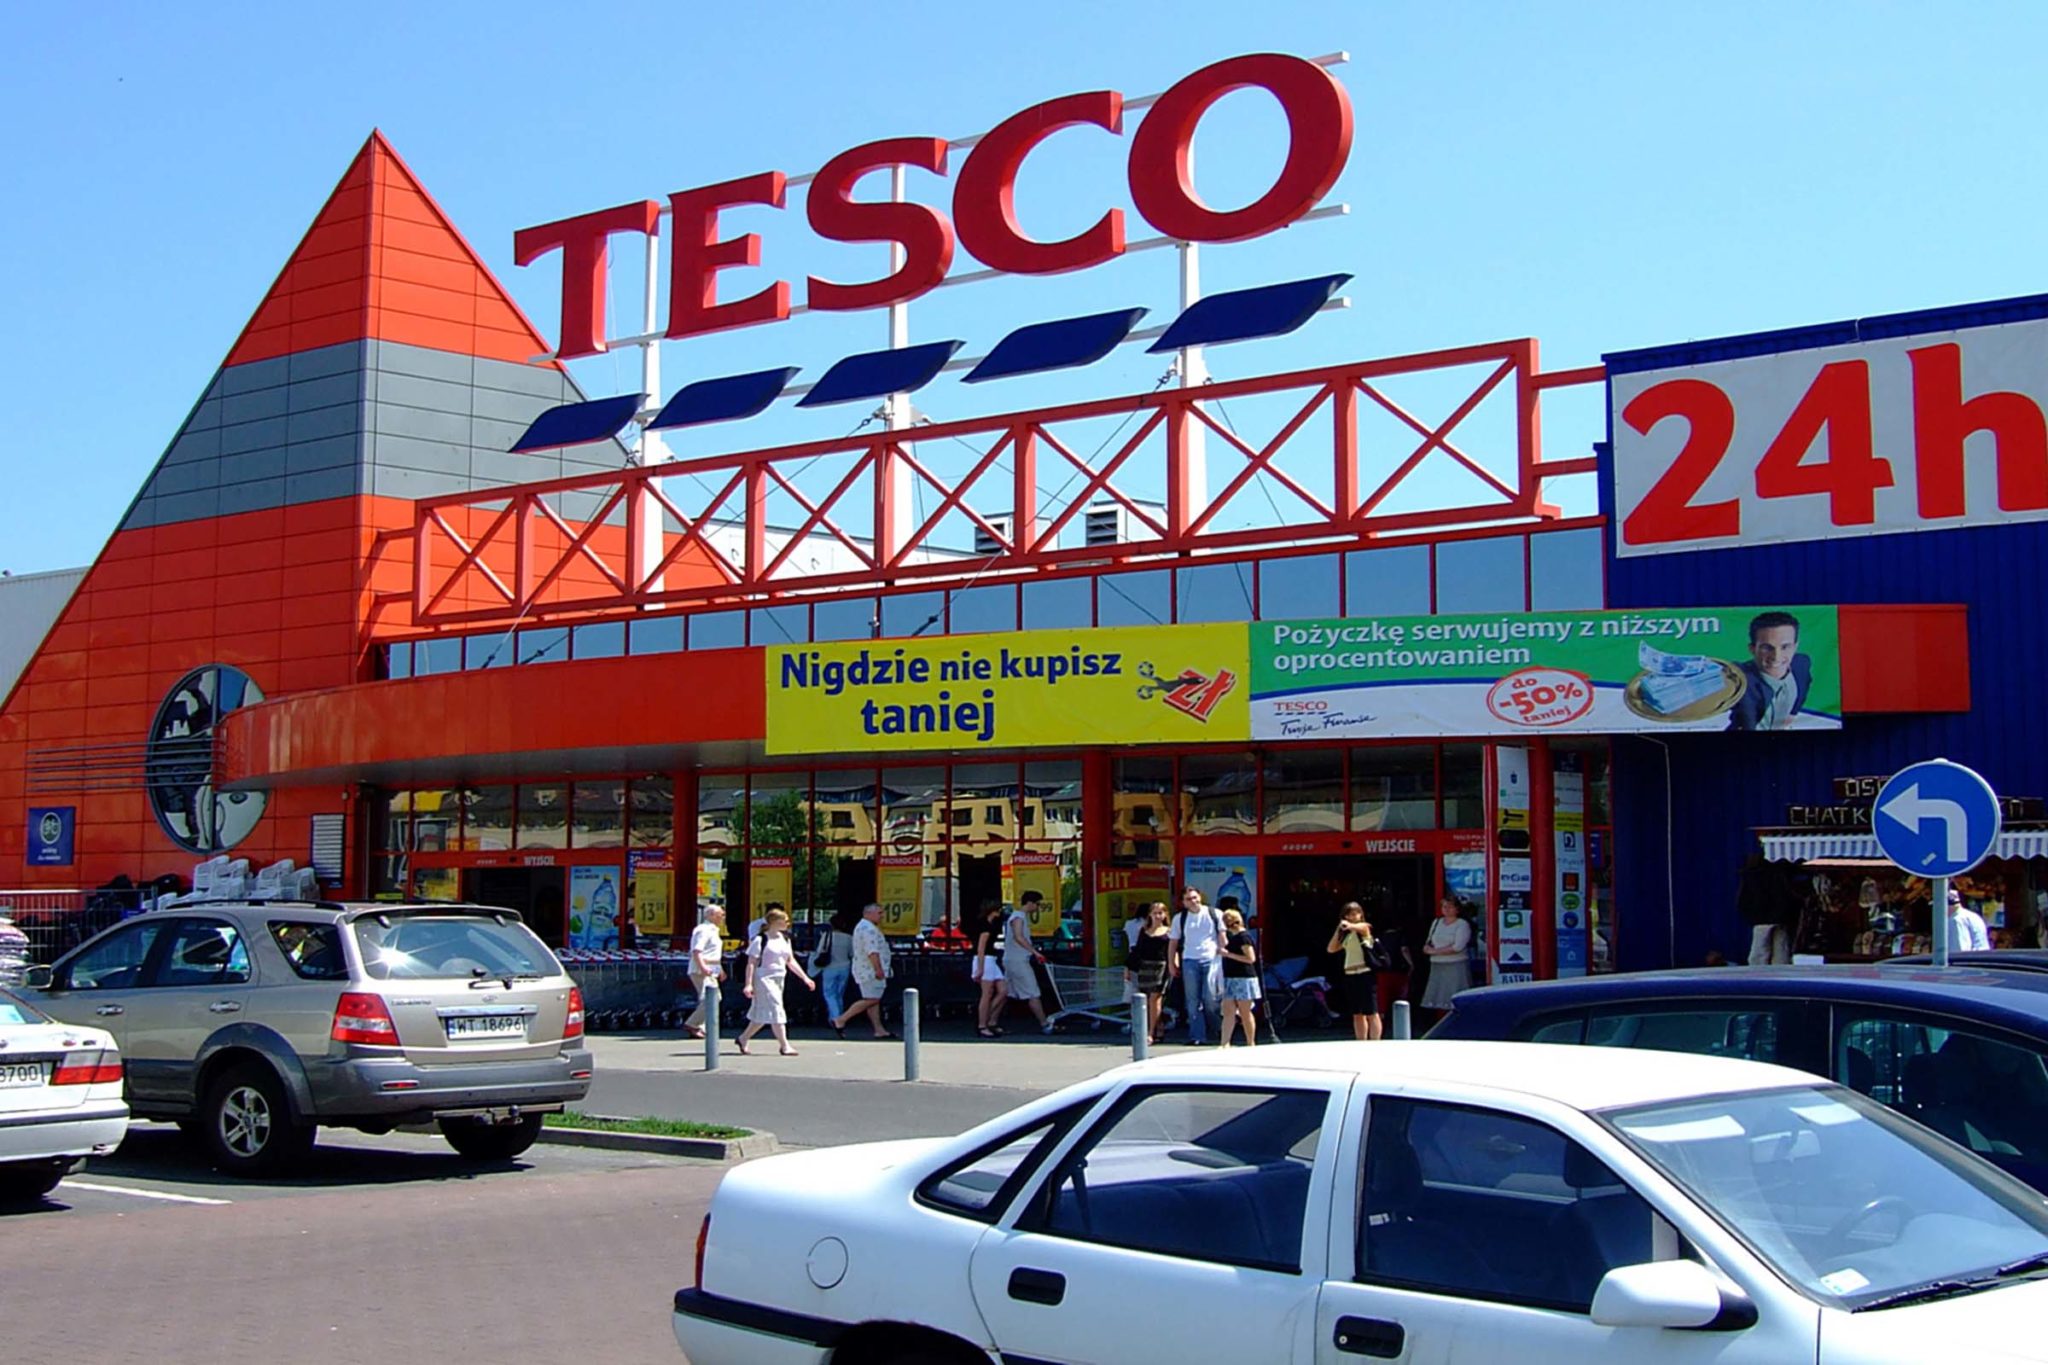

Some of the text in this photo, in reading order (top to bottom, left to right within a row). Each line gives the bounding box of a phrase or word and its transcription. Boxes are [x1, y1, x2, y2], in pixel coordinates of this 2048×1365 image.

[514, 52, 1354, 360] TESCO
[1621, 342, 2048, 546] 24h
[1273, 614, 1720, 650] Pożyczkę serwujemy z niższym
[1273, 644, 1531, 675] oprocentowaniem
[780, 645, 1122, 697] Nigdzie nie kupisz
[1511, 678, 1538, 690] do
[1273, 700, 1329, 712] TESCO
[1498, 682, 1584, 716] -50%
[861, 689, 996, 742] taniej
[1523, 704, 1572, 723] taniej
[1789, 805, 1873, 825] CHATK
[1365, 838, 1416, 853] WEJŚCIE
[880, 856, 921, 865] PROMOCJA
[1100, 871, 1132, 889] HIT
[457, 1016, 522, 1034] WT 18696
